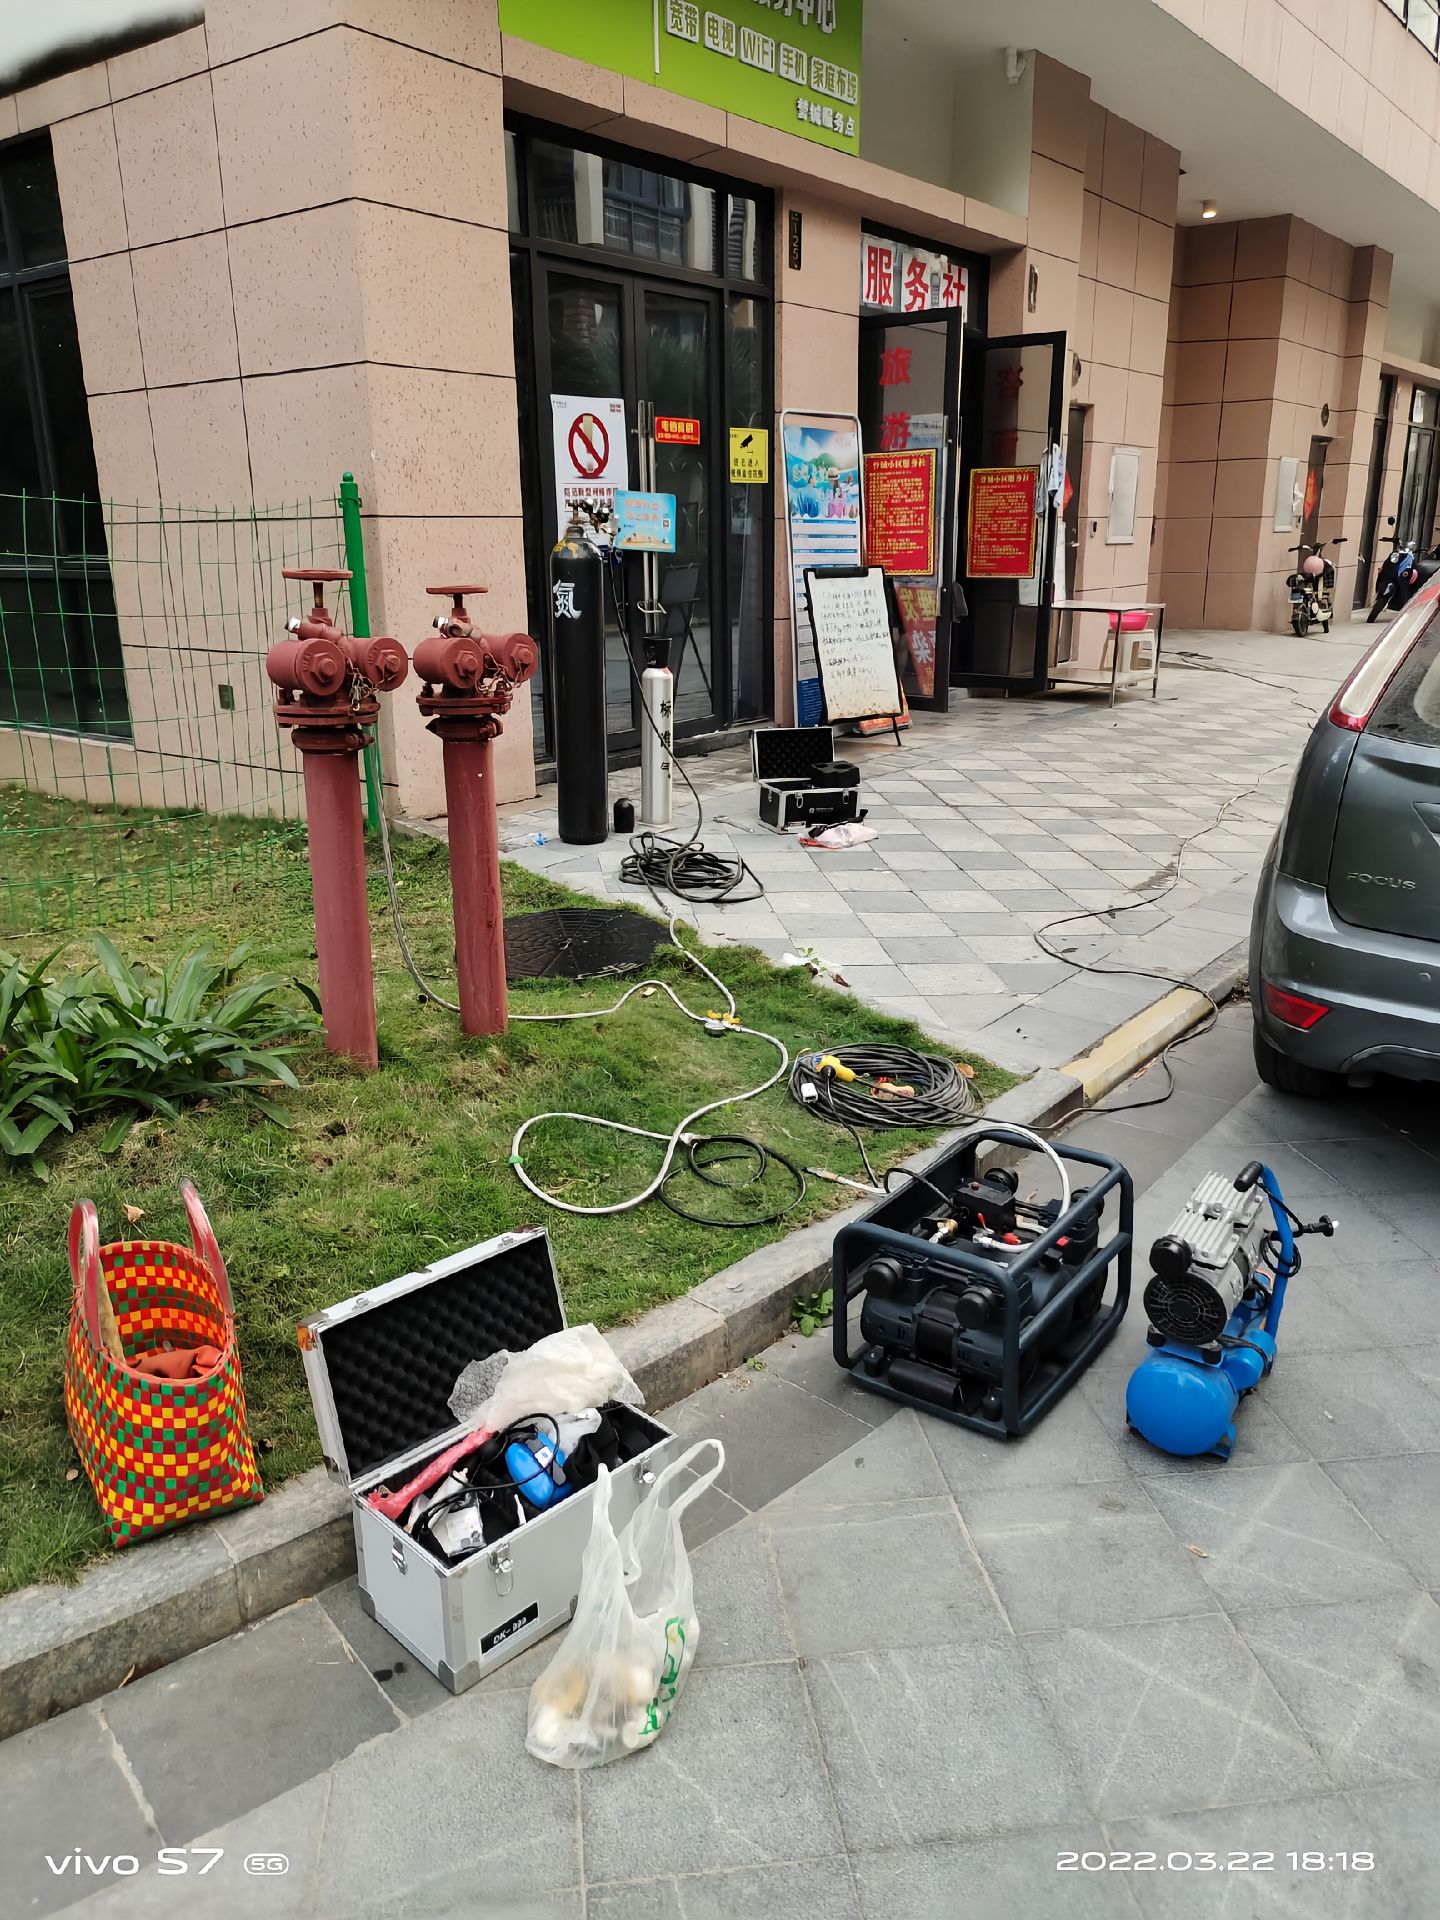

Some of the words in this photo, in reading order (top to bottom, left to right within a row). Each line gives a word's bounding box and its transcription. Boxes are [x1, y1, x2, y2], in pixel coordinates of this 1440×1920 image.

[669, 0, 698, 39] 宽带
[707, 15, 735, 54] 电视
[742, 29, 775, 70] WiFi
[782, 47, 805, 81] 手机
[812, 60, 858, 99] 家庭布线
[866, 245, 966, 312] 服务社
[552, 578, 582, 619] 氮
[1347, 872, 1416, 890] FOCUS
